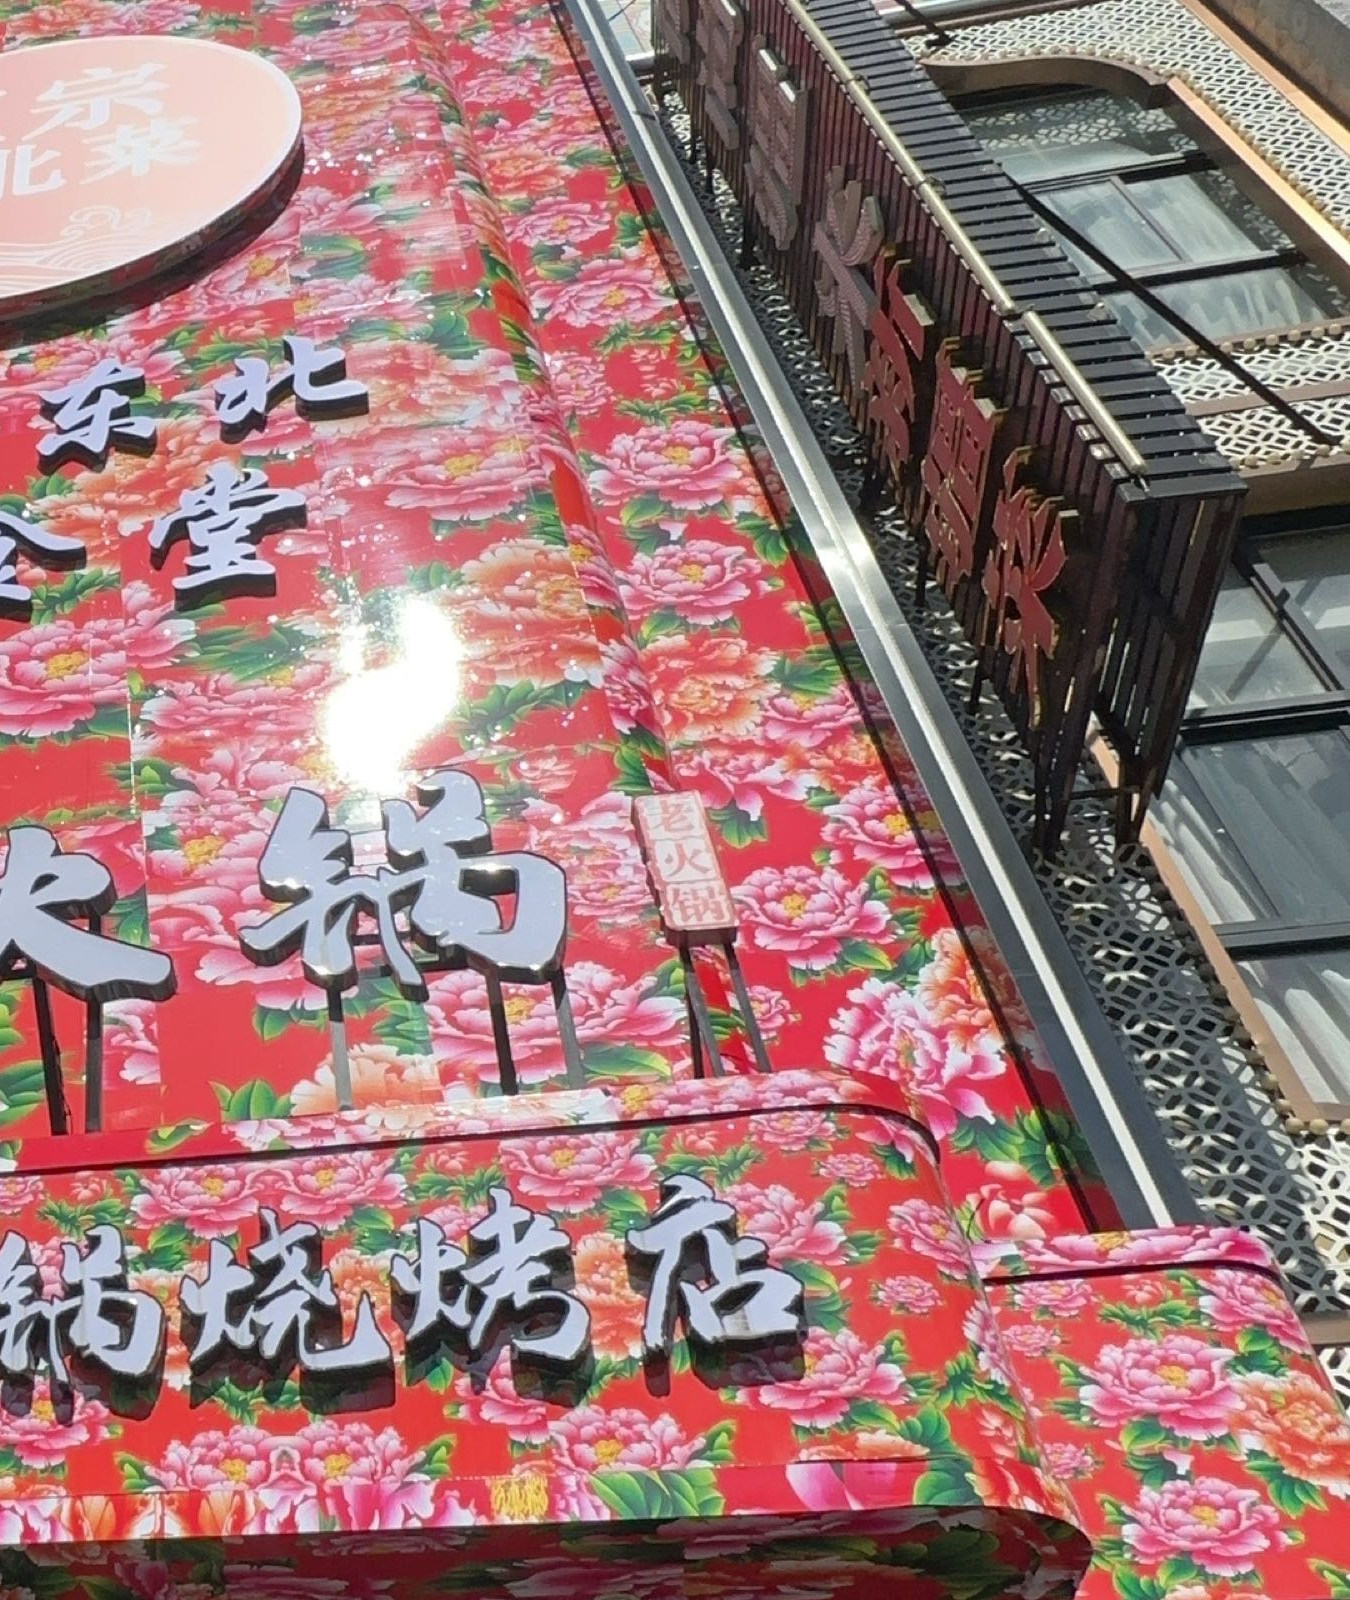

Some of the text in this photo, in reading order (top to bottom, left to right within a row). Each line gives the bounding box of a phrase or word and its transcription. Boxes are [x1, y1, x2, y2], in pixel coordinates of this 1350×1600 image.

[861, 246, 1070, 731] 新疆菜
[649, 796, 727, 924] 老火锅
